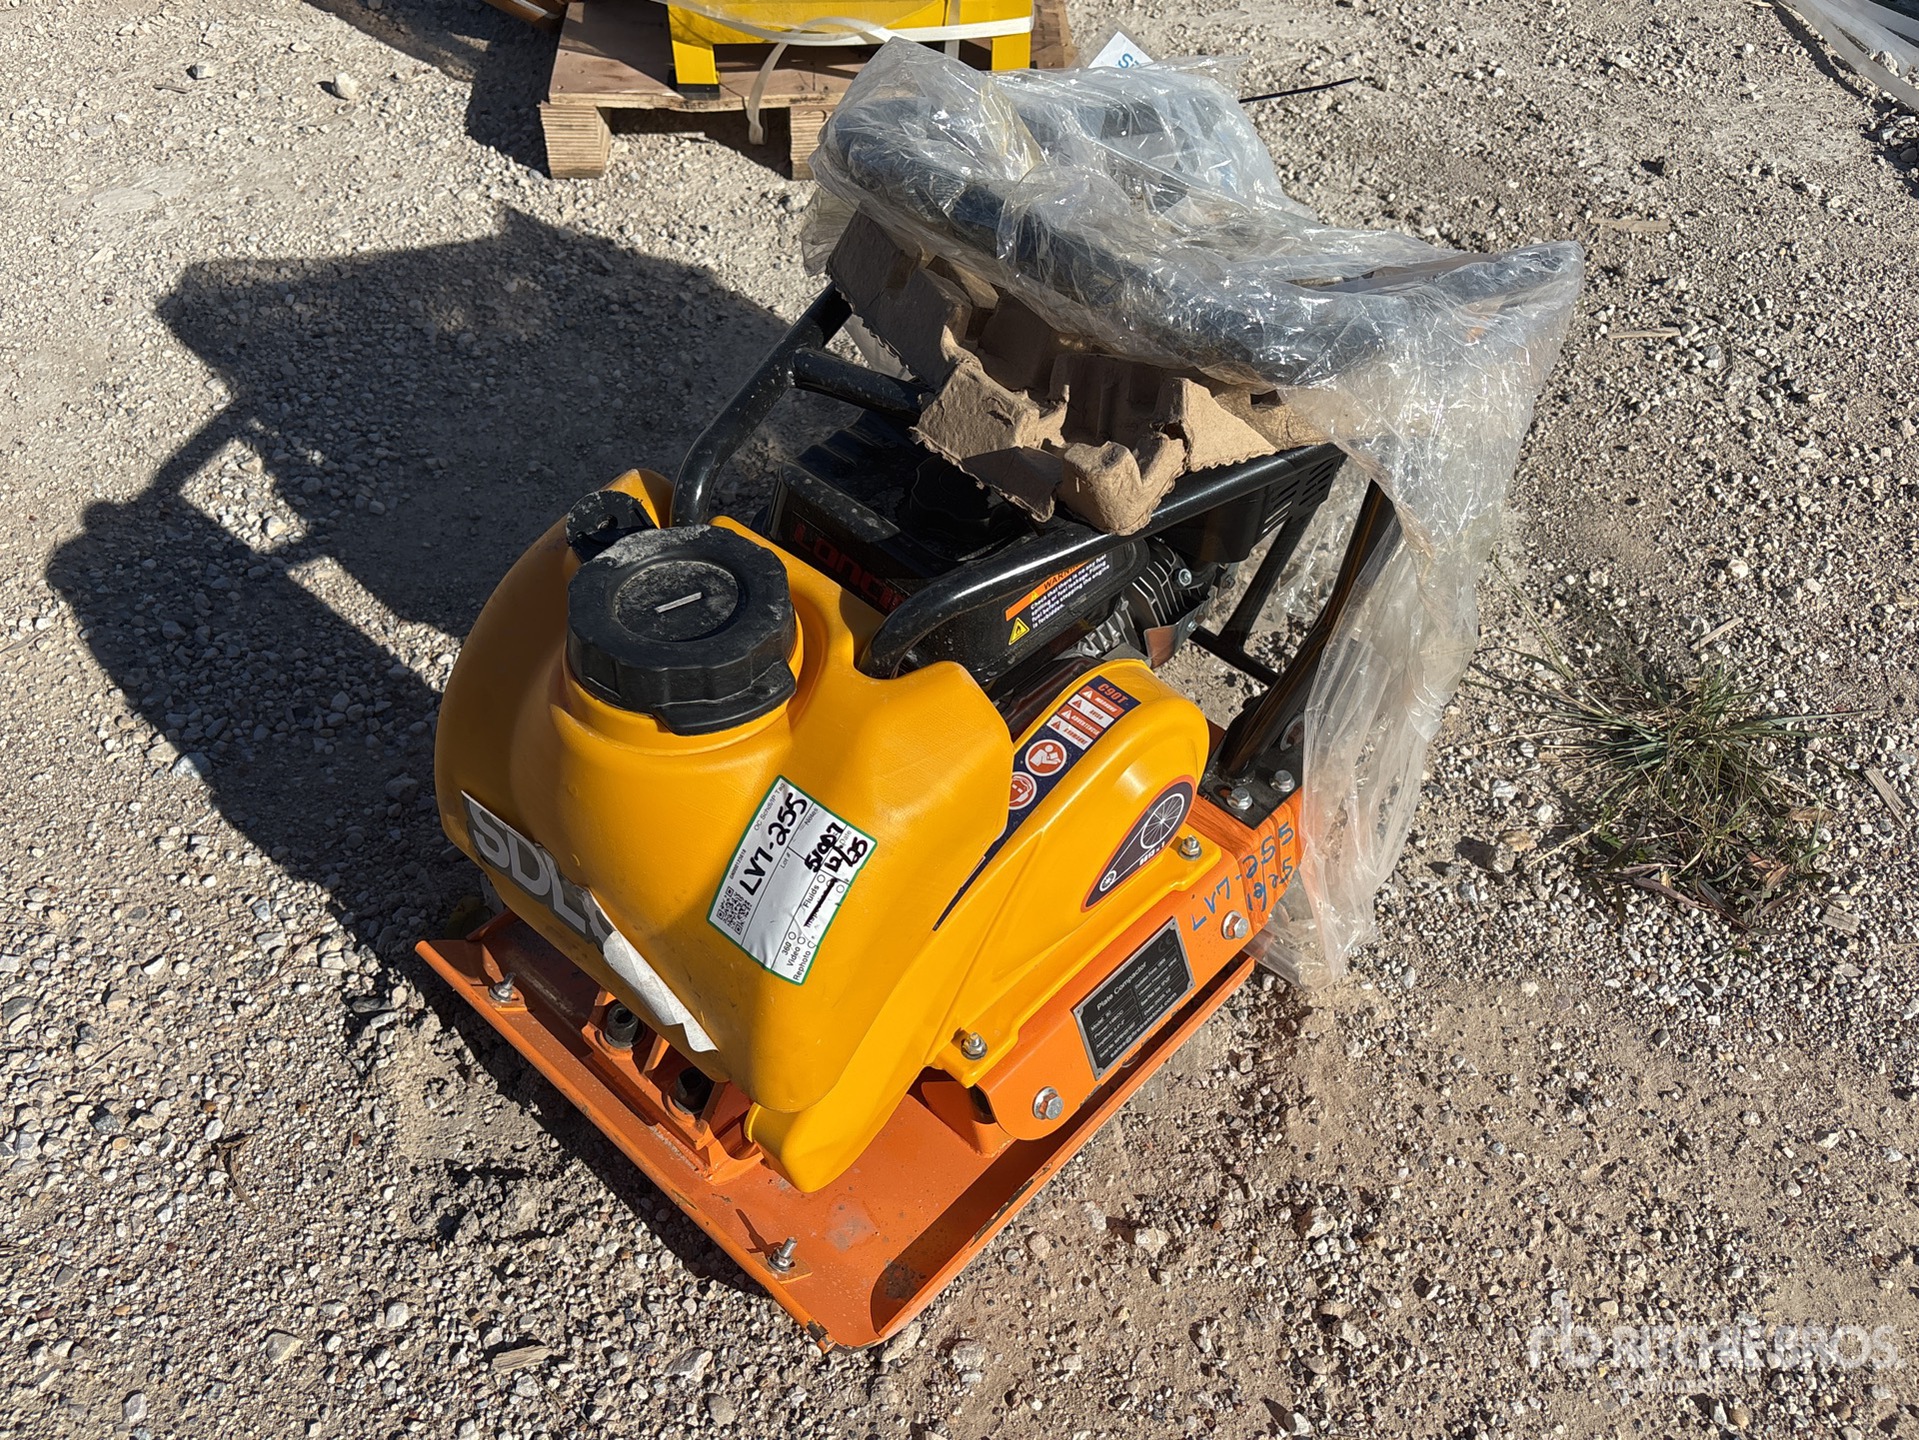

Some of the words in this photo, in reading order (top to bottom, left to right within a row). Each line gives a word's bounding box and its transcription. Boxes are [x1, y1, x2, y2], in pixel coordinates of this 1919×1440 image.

[1098, 683, 1128, 704] C90T
[804, 807, 818, 826] Notes
[840, 829, 852, 845] Date
[780, 858, 790, 869] Lot
[803, 885, 820, 908] Fluids
[782, 943, 792, 955] 360
[787, 946, 800, 967] Video
[793, 950, 811, 981] Rephoto
[1096, 993, 1113, 1010] Plate
[1113, 961, 1147, 995] Compactor
